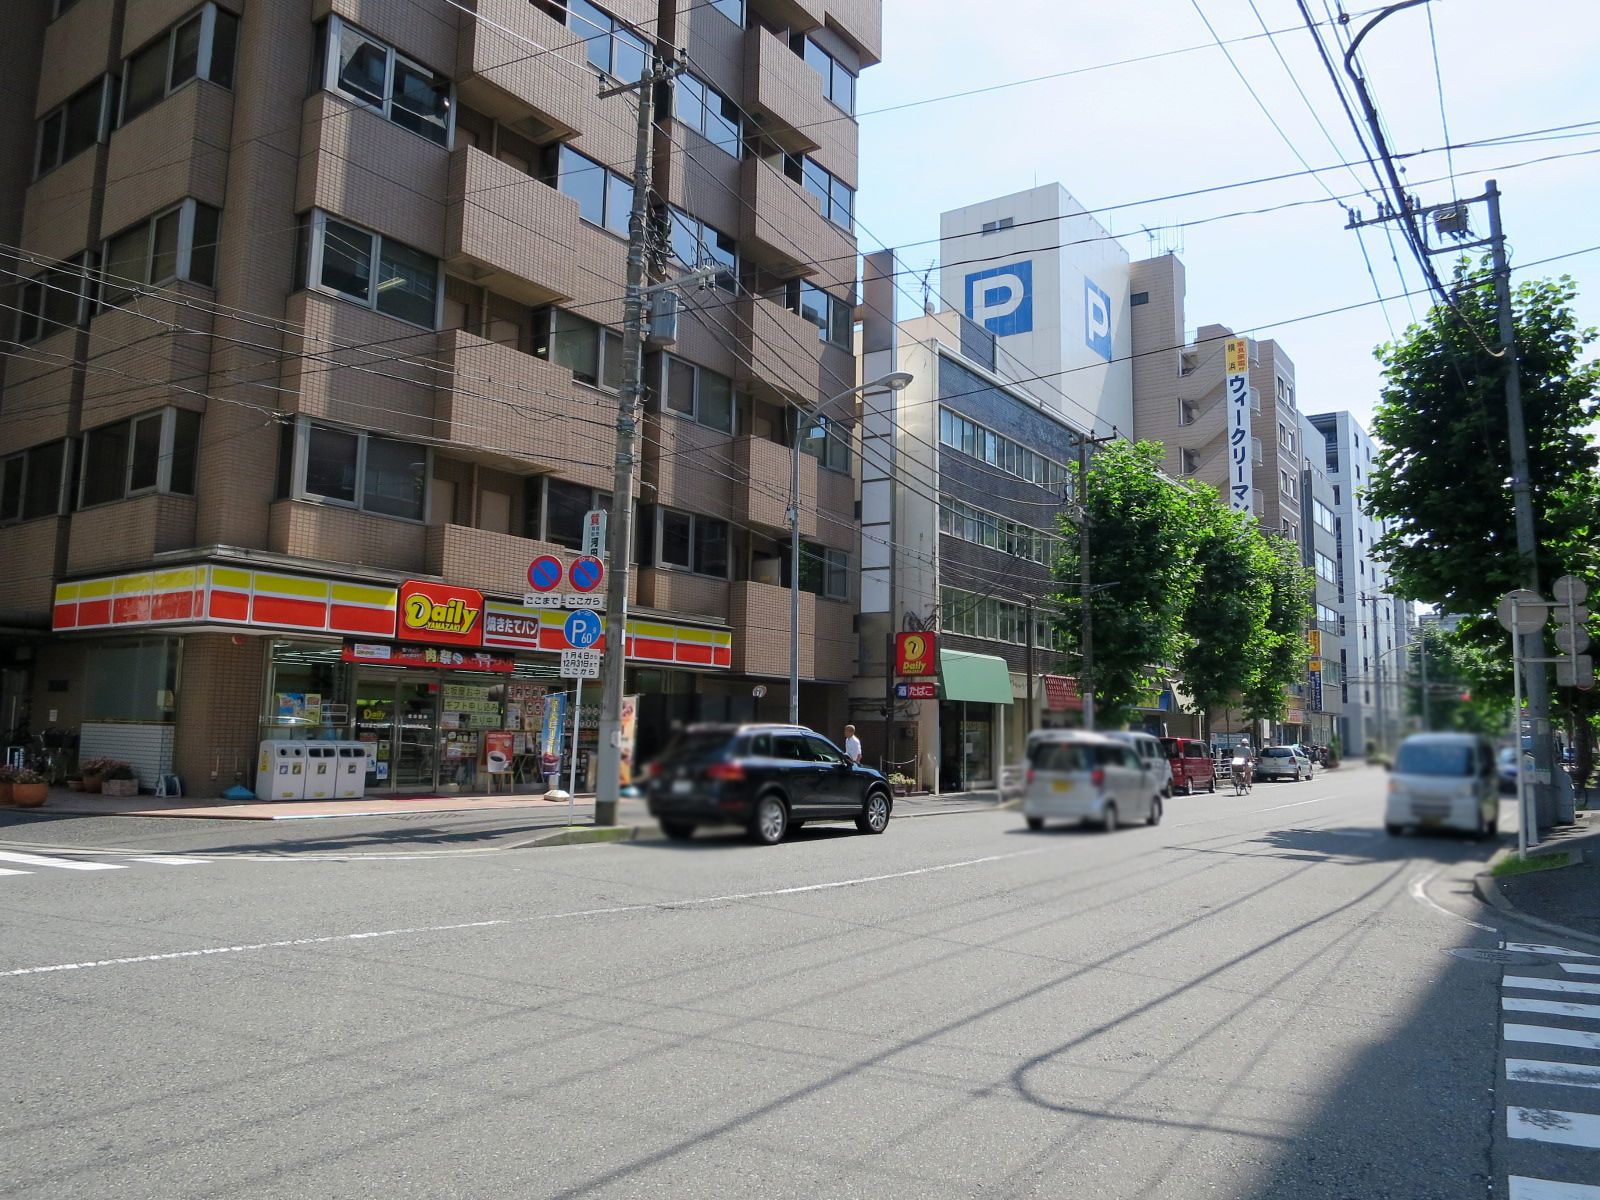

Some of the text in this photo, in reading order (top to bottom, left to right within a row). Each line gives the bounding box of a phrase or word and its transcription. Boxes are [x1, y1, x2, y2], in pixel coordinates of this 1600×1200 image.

[972, 274, 1025, 330] P
[1087, 286, 1110, 343] P
[1227, 343, 1236, 371] 横浜
[526, 596, 559, 605] ここまで
[568, 596, 600, 605] ここから
[406, 594, 479, 633] Daily
[427, 622, 461, 632] YAMAZAKI
[486, 616, 538, 636] 焼きたてパン
[572, 620, 586, 643] P
[581, 633, 592, 644] 60
[564, 668, 596, 676] ここから
[903, 661, 926, 673] Daily
[909, 686, 933, 696] たばこ
[363, 709, 386, 720] Daily
